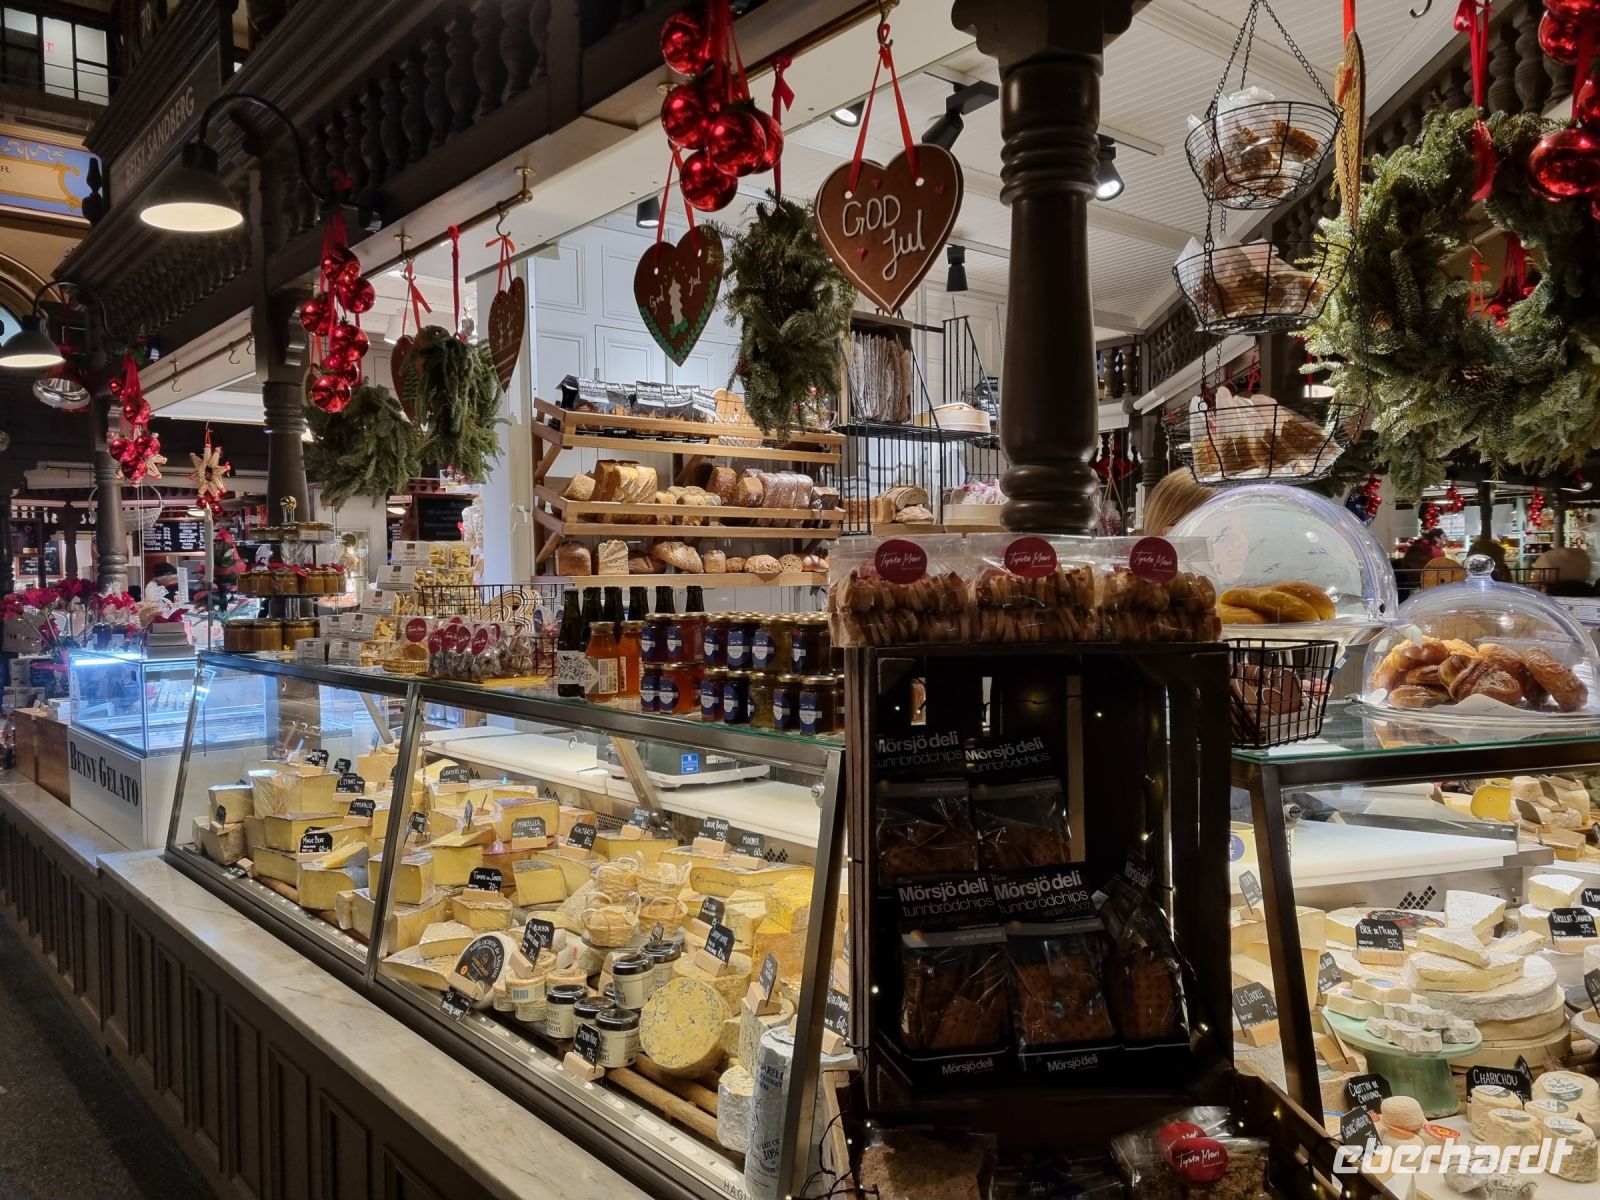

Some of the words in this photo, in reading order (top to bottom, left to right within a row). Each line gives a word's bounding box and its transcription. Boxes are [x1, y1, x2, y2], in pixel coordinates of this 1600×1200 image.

[126, 142, 146, 187] BETSY
[147, 86, 195, 153] SANDBERG
[842, 194, 901, 237] GOD
[929, 730, 960, 748] deli
[965, 743, 1016, 762] Mörsjö
[1015, 736, 1045, 754] deli
[69, 741, 97, 784] BETSY
[98, 756, 140, 807] GELATO
[898, 881, 958, 904] Mörsjö
[957, 877, 989, 897] deli
[993, 876, 1050, 901] Mörsjö
[1050, 870, 1083, 890] deli
[942, 1060, 976, 1077] Mörsjö
[975, 1057, 994, 1070] deli
[1047, 1057, 1082, 1073] Mörsjö
[1080, 1053, 1099, 1067] deli
[1472, 1069, 1518, 1086] CHABICHOU
